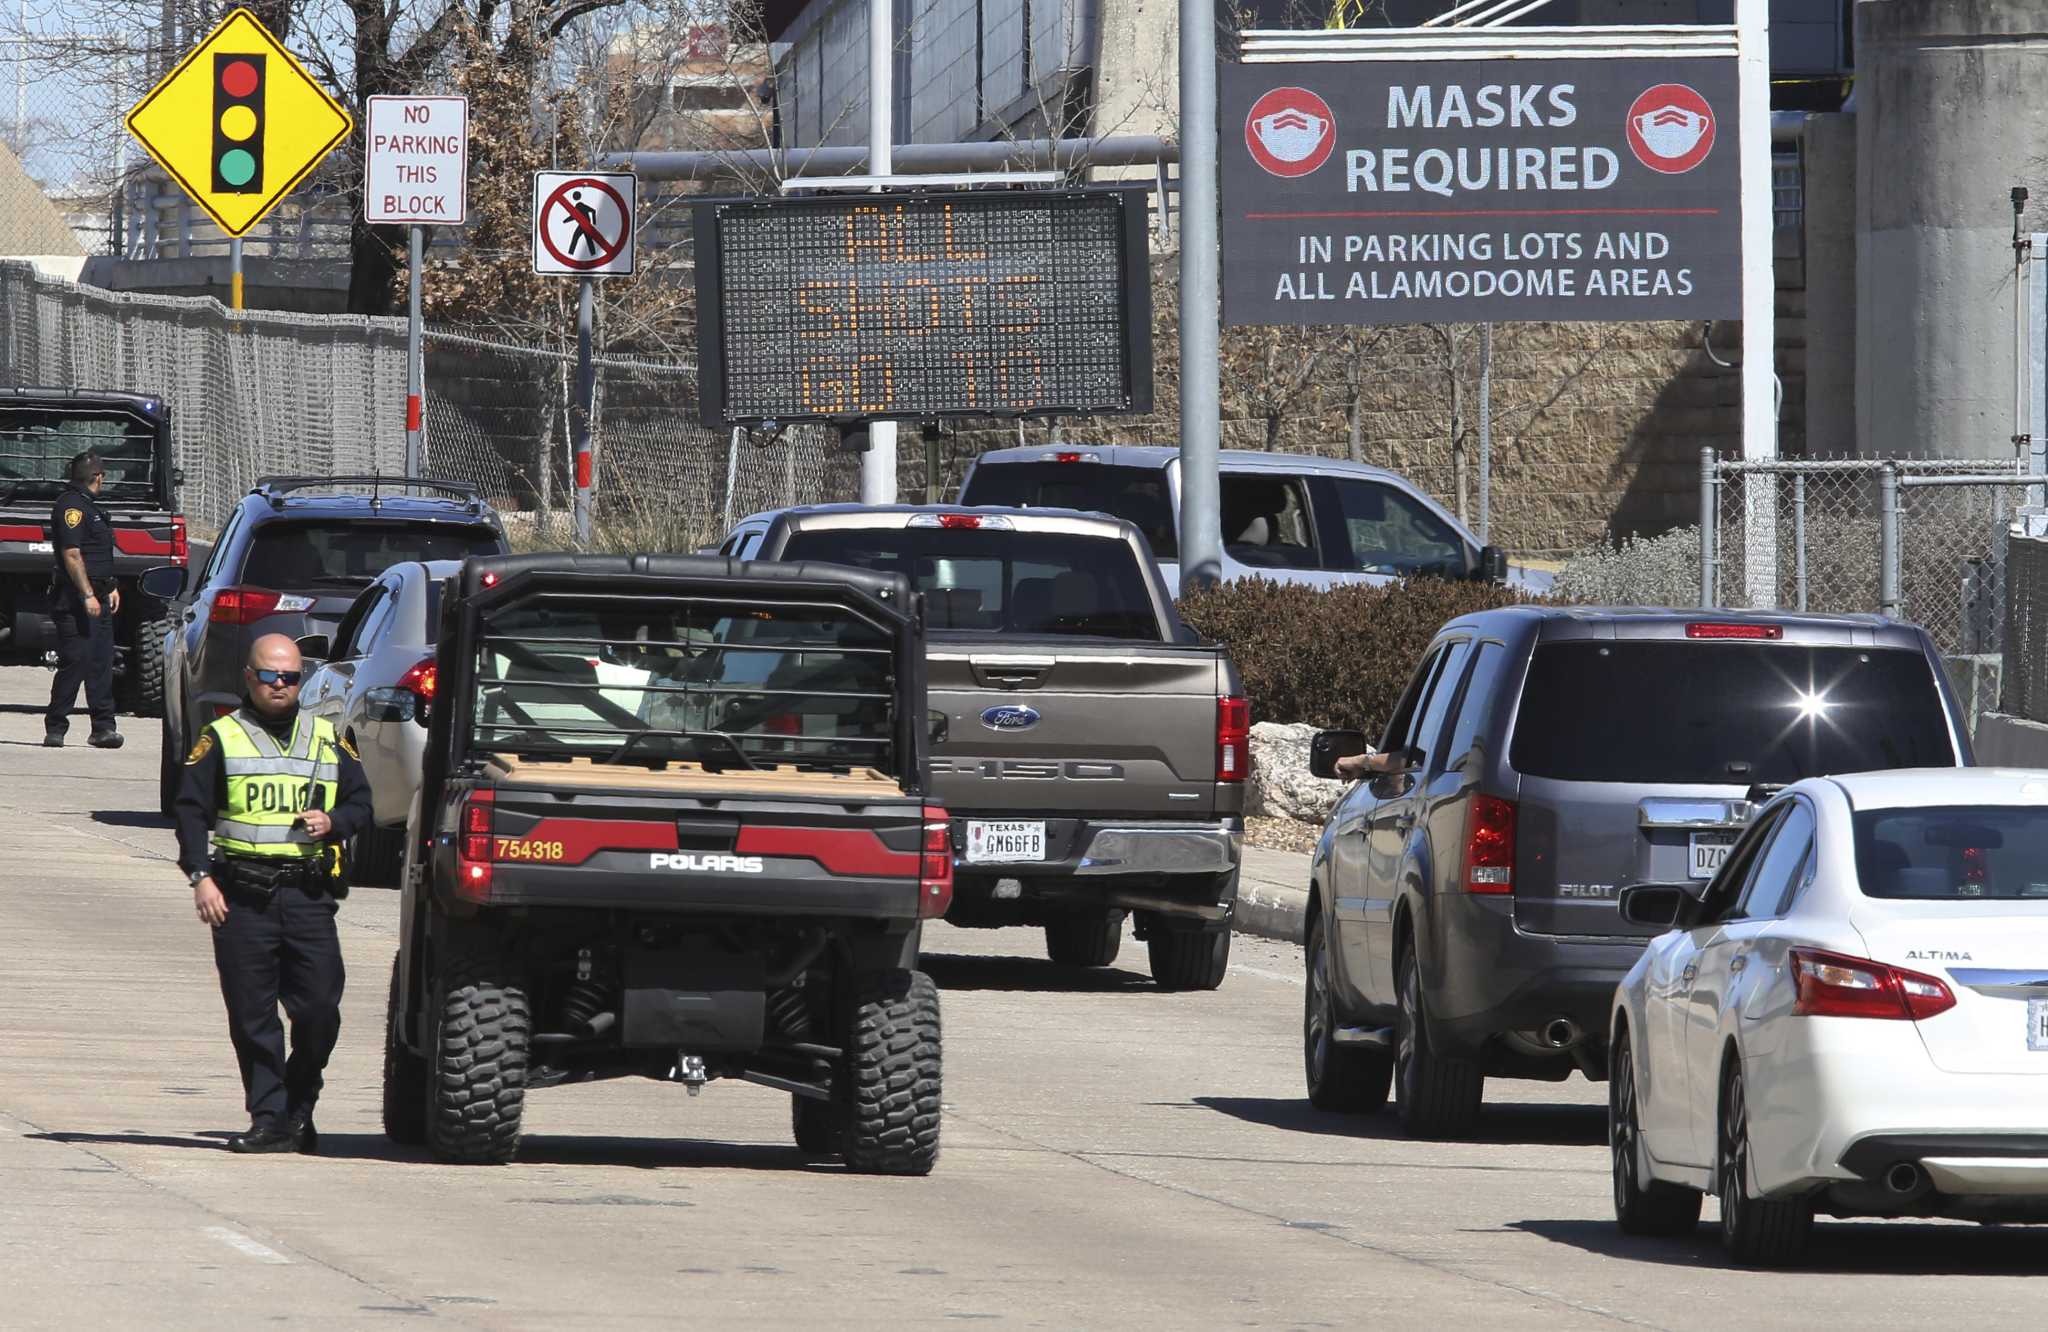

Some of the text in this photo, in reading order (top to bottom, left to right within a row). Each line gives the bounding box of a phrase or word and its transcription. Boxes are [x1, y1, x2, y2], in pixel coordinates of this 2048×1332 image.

[404, 105, 430, 123] NO
[1387, 83, 1577, 129] MASKS
[374, 136, 459, 155] PARKING
[396, 165, 437, 183] THIS
[1345, 146, 1620, 198] REQUIRED
[383, 196, 445, 214] BLOCK
[846, 203, 987, 263] ALL
[1299, 231, 1670, 264] IN PARKING LOTS AND
[1275, 267, 1693, 301] ALL ALAMODOME AREAS
[803, 350, 1041, 412] GO TO
[988, 824, 1025, 832] TEXAS
[498, 840, 563, 860] 754318
[650, 854, 763, 873] POLARIS
[1559, 884, 1614, 897] PILOT
[1905, 950, 1973, 961] ALTIMA
